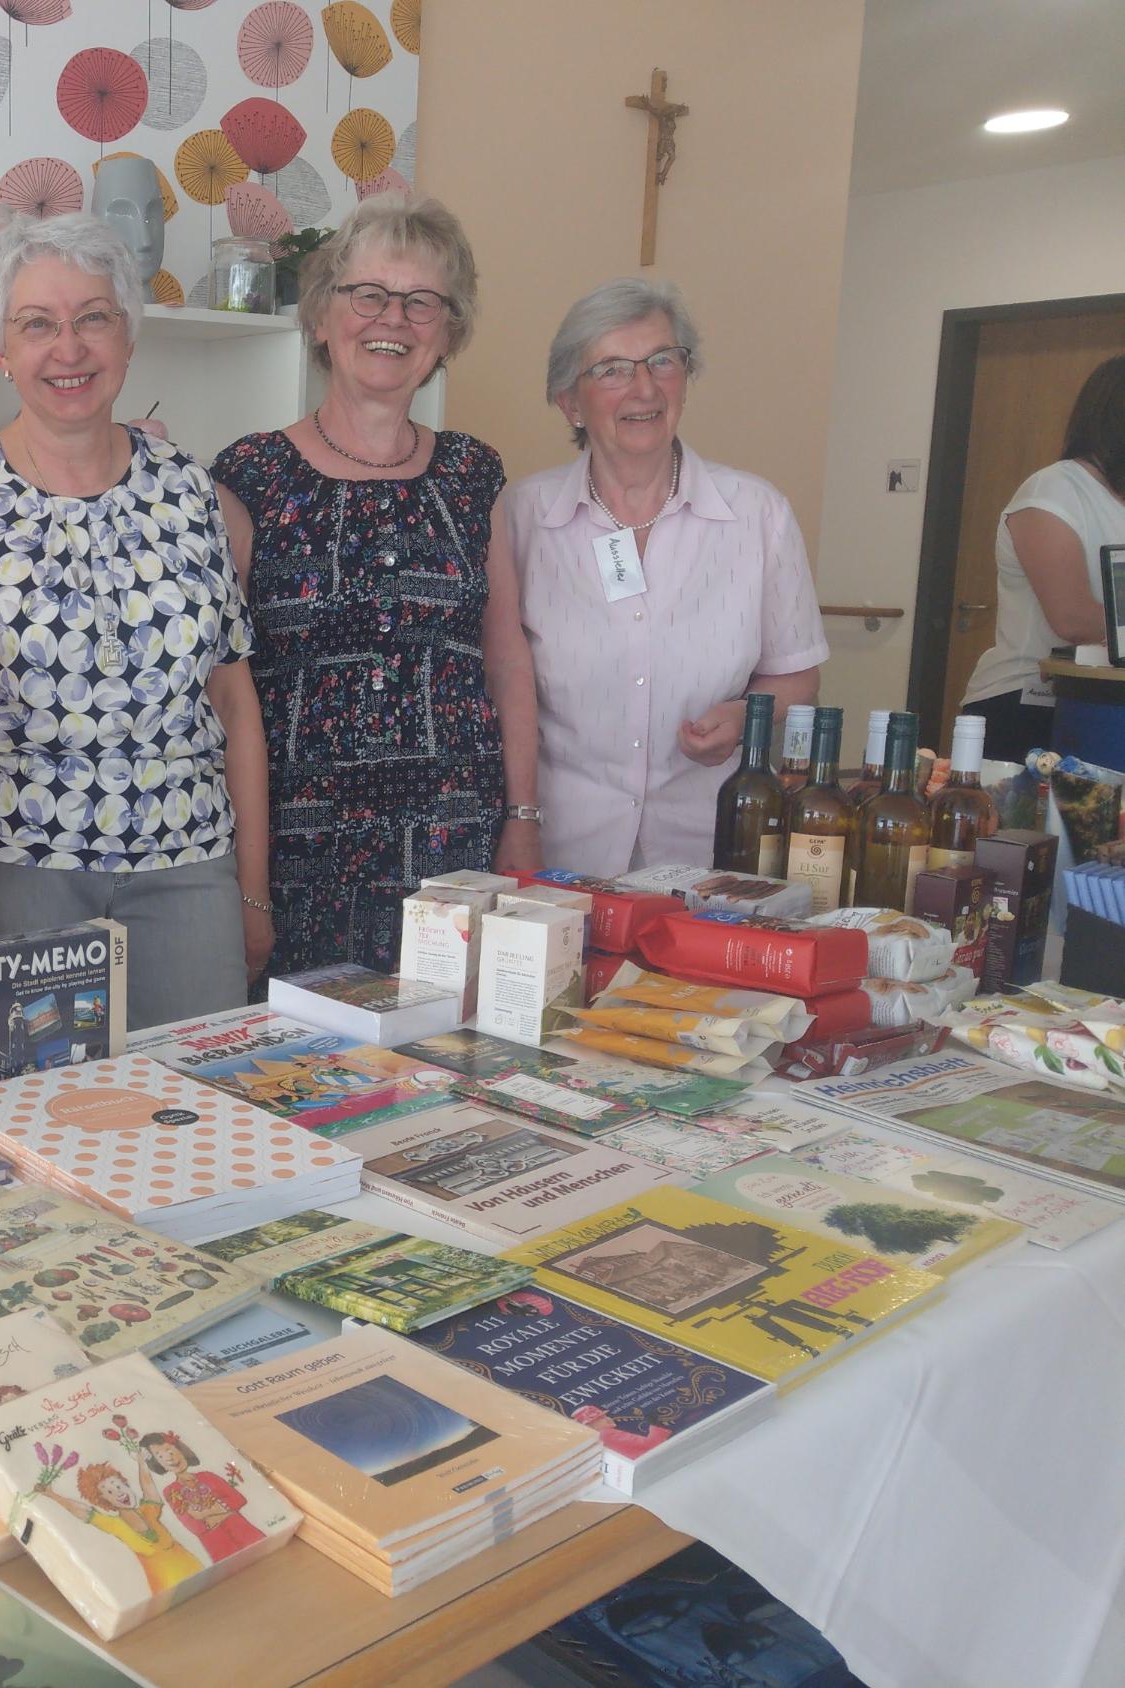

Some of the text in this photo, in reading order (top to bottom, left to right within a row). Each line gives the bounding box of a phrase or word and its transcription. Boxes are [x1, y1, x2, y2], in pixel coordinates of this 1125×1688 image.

[114, 936, 124, 966] HOF
[12, 981, 22, 990] Die
[66, 970, 86, 980] kennen
[87, 966, 106, 976] lernen
[178, 1027, 315, 1068] BIERAMIDEN
[815, 1057, 977, 1098] Heinrichsblatt
[390, 1126, 443, 1147] Beate Franck
[465, 1169, 574, 1213] Von Häusern
[521, 1160, 635, 1209] und Menschen
[219, 1327, 294, 1355] BUCHGALERIE
[476, 1318, 562, 1357] ROYALE
[493, 1325, 604, 1377] MOMENTE
[236, 1351, 346, 1395] Gott Raum geben
[535, 1343, 622, 1385] FÜR DIE
[558, 1352, 665, 1407] EWIGKEIT
